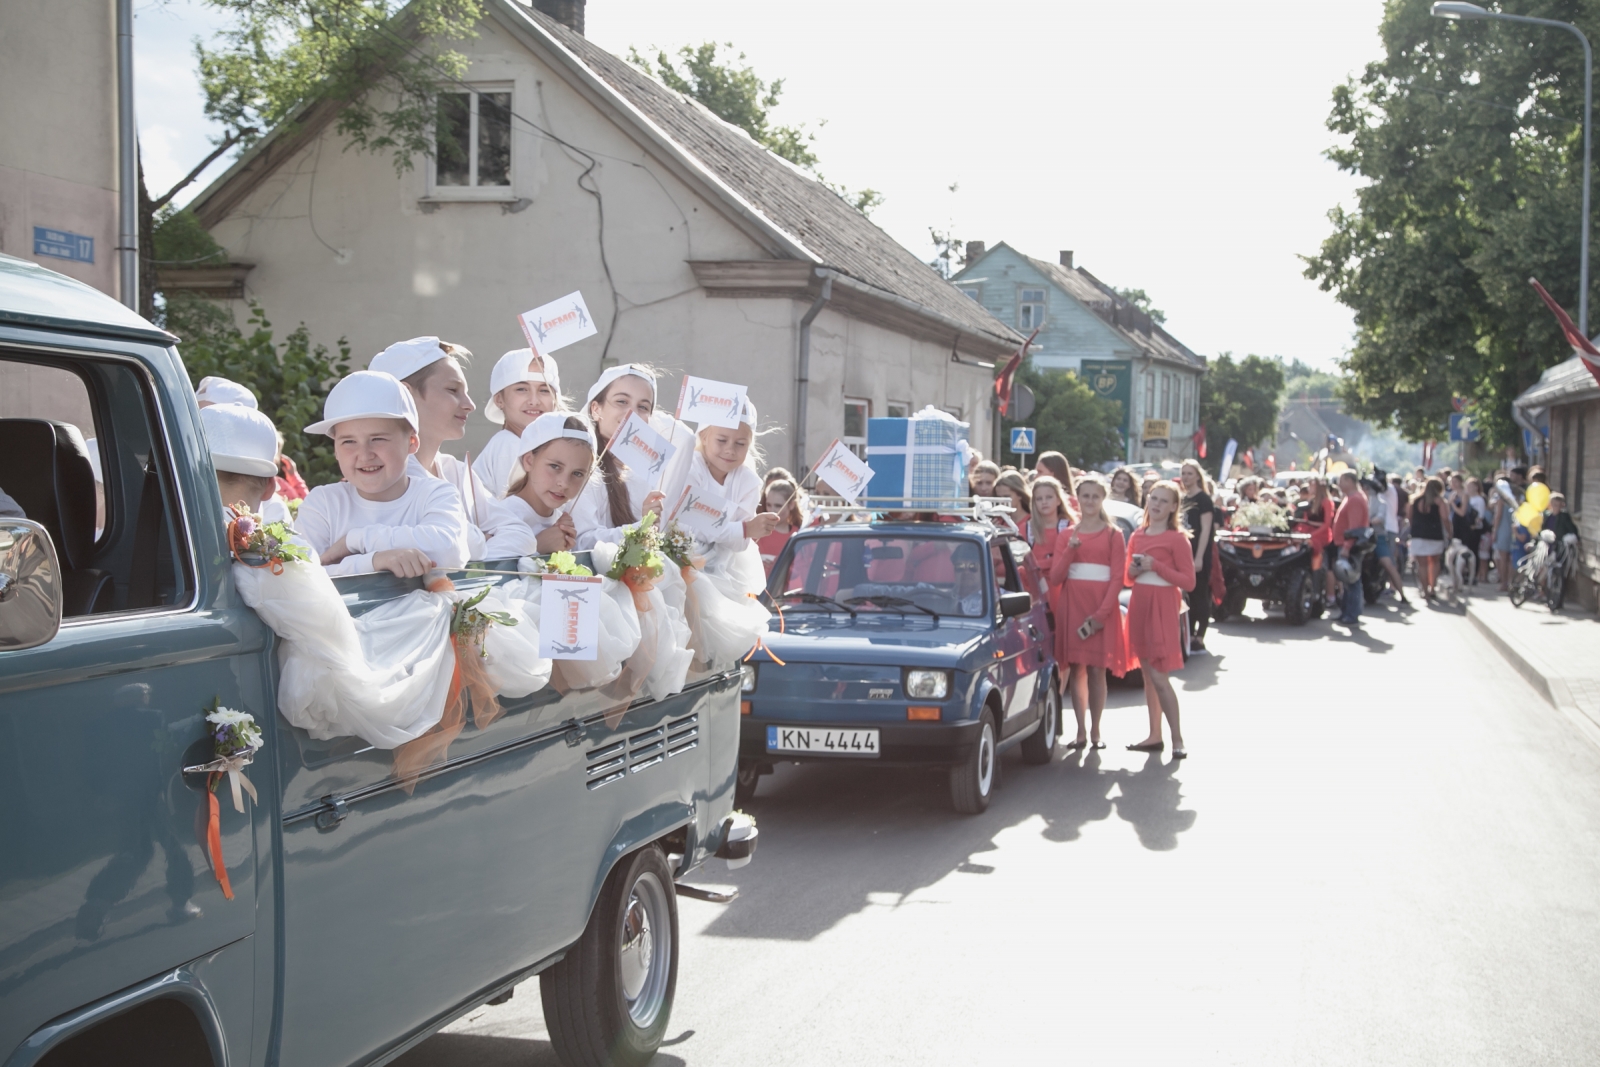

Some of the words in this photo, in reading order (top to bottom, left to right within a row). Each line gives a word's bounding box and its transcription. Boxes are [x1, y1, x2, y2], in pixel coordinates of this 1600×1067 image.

[79, 239, 91, 259] 17
[543, 311, 577, 330] DEMO
[1098, 377, 1115, 389] BP
[700, 394, 733, 407] DEMO
[1148, 421, 1167, 430] AUTO
[632, 435, 659, 462] DEMO
[835, 460, 859, 482] DEMO
[694, 501, 721, 519] DEMO
[565, 601, 579, 645] DEMO
[782, 730, 875, 751] KN-4444
